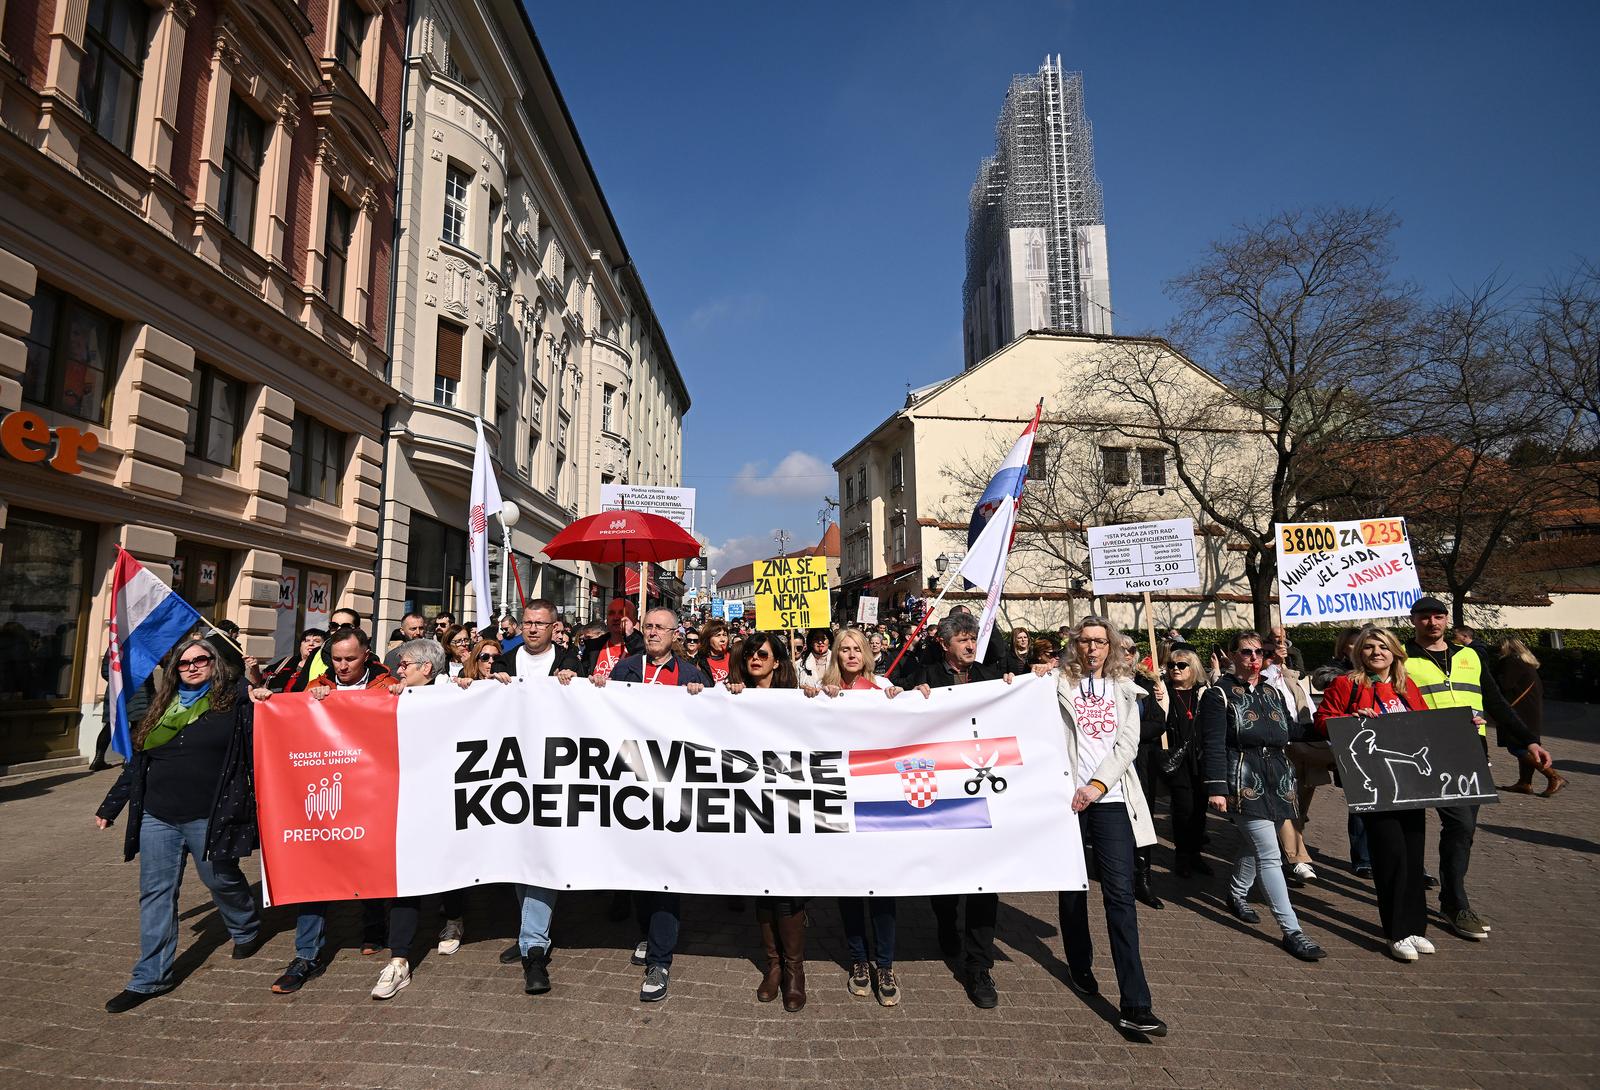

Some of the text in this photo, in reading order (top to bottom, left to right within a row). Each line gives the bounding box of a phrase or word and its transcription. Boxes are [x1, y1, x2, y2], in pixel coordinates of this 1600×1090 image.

[1, 411, 99, 474] er
[1132, 534, 1179, 544] KOEFICIJENTIMA
[1283, 527, 1335, 552] 38000
[1339, 528, 1364, 547] ZA
[762, 558, 816, 577] ZNA SE,
[1154, 562, 1179, 572] 3,00
[1340, 548, 1381, 570] SADA
[203, 568, 212, 580] M
[1108, 566, 1131, 576] 2,01
[1281, 550, 1335, 592] MINISTRE,
[1347, 559, 1403, 589] JASNIJE
[755, 578, 773, 595] ZA
[1125, 577, 1169, 589] Kako to?
[279, 585, 290, 600] M
[313, 590, 324, 604] M
[773, 593, 809, 611] NEMA
[1286, 594, 1312, 616] ZA
[289, 748, 363, 760] ŠKOLSKI SINDIKAT
[293, 757, 357, 767] SCHOOL UNION
[454, 736, 847, 787] ZA PRAVEDNE
[454, 780, 850, 834] KOEFICIJENTE
[284, 826, 365, 843] PREPOROD
